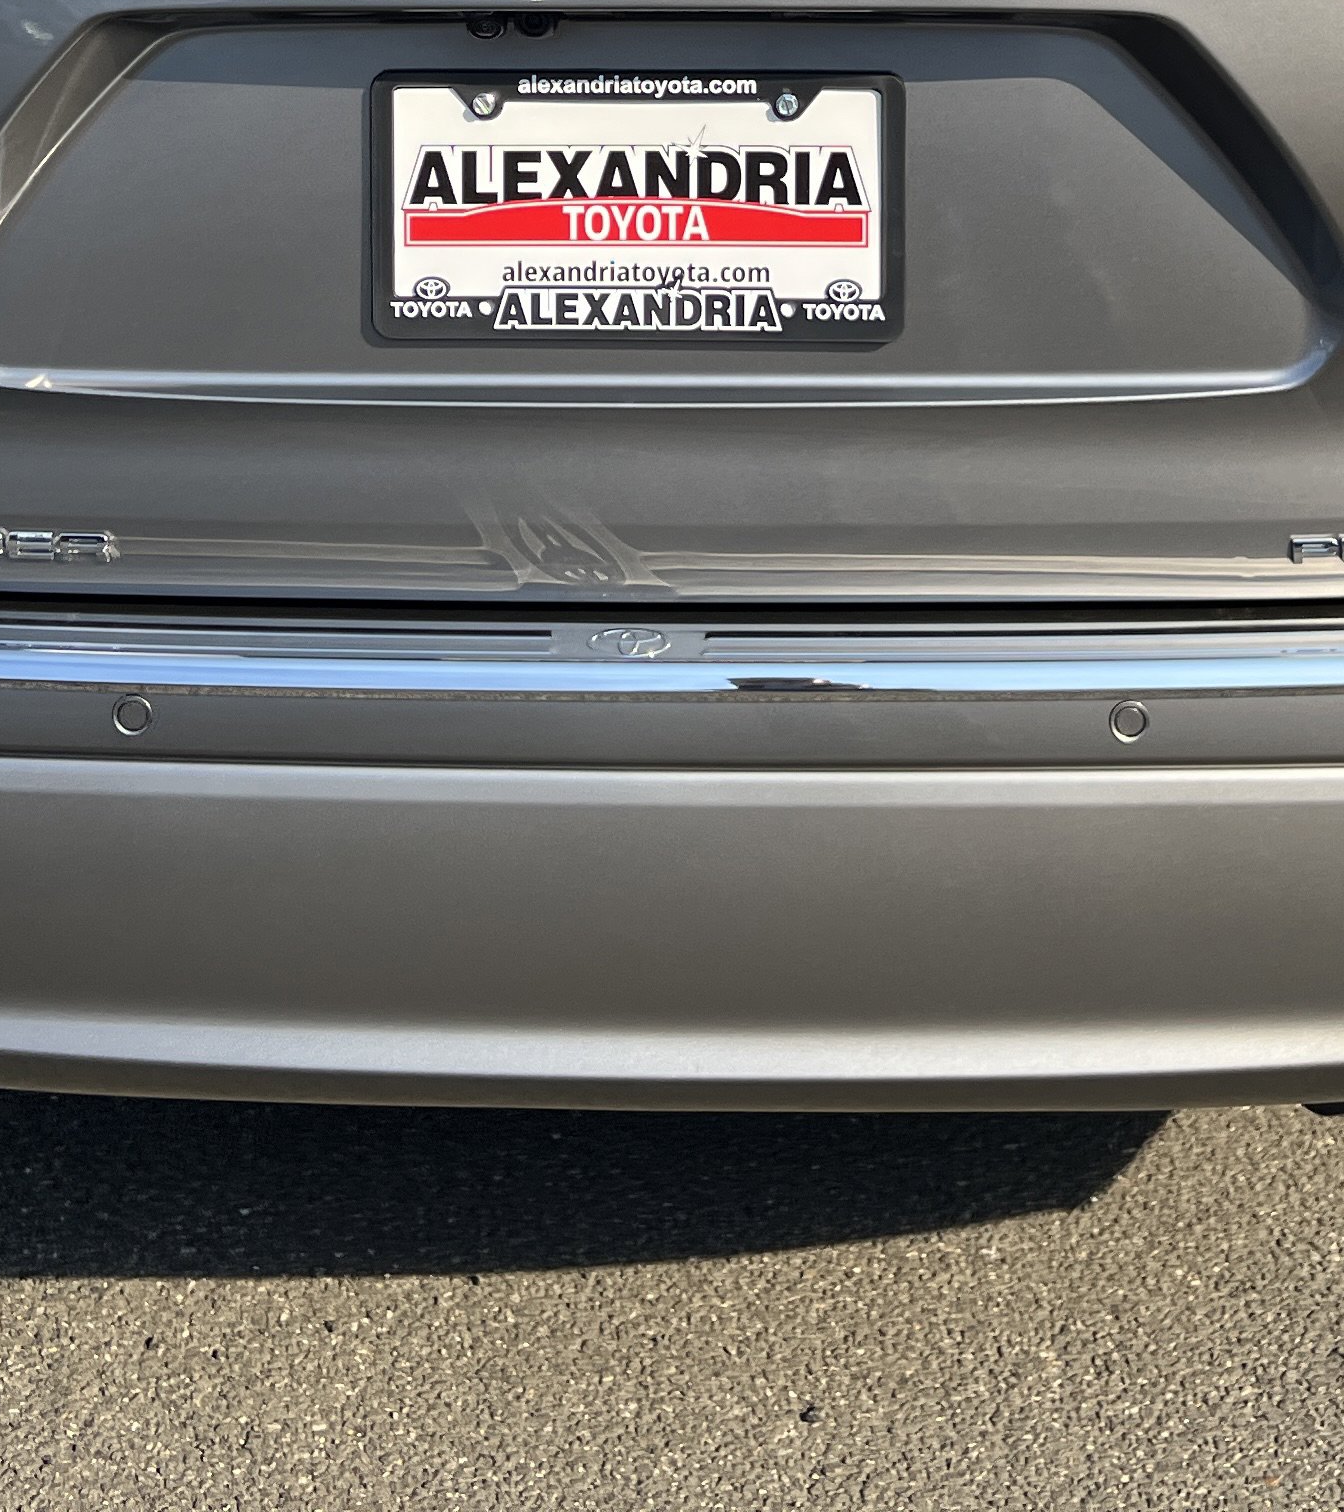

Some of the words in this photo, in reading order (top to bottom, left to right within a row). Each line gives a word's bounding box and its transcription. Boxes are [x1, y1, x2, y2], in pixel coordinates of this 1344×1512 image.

[517, 75, 758, 98] alexandriatoyota.com
[408, 148, 862, 207] ALEXANDRIA
[561, 204, 711, 242] TOYOTA
[501, 261, 771, 289] alexandriatoyota.com
[390, 300, 473, 320] TOYOTA
[496, 291, 780, 330] ALEXANDRIA
[803, 302, 886, 322] TOYOTA
